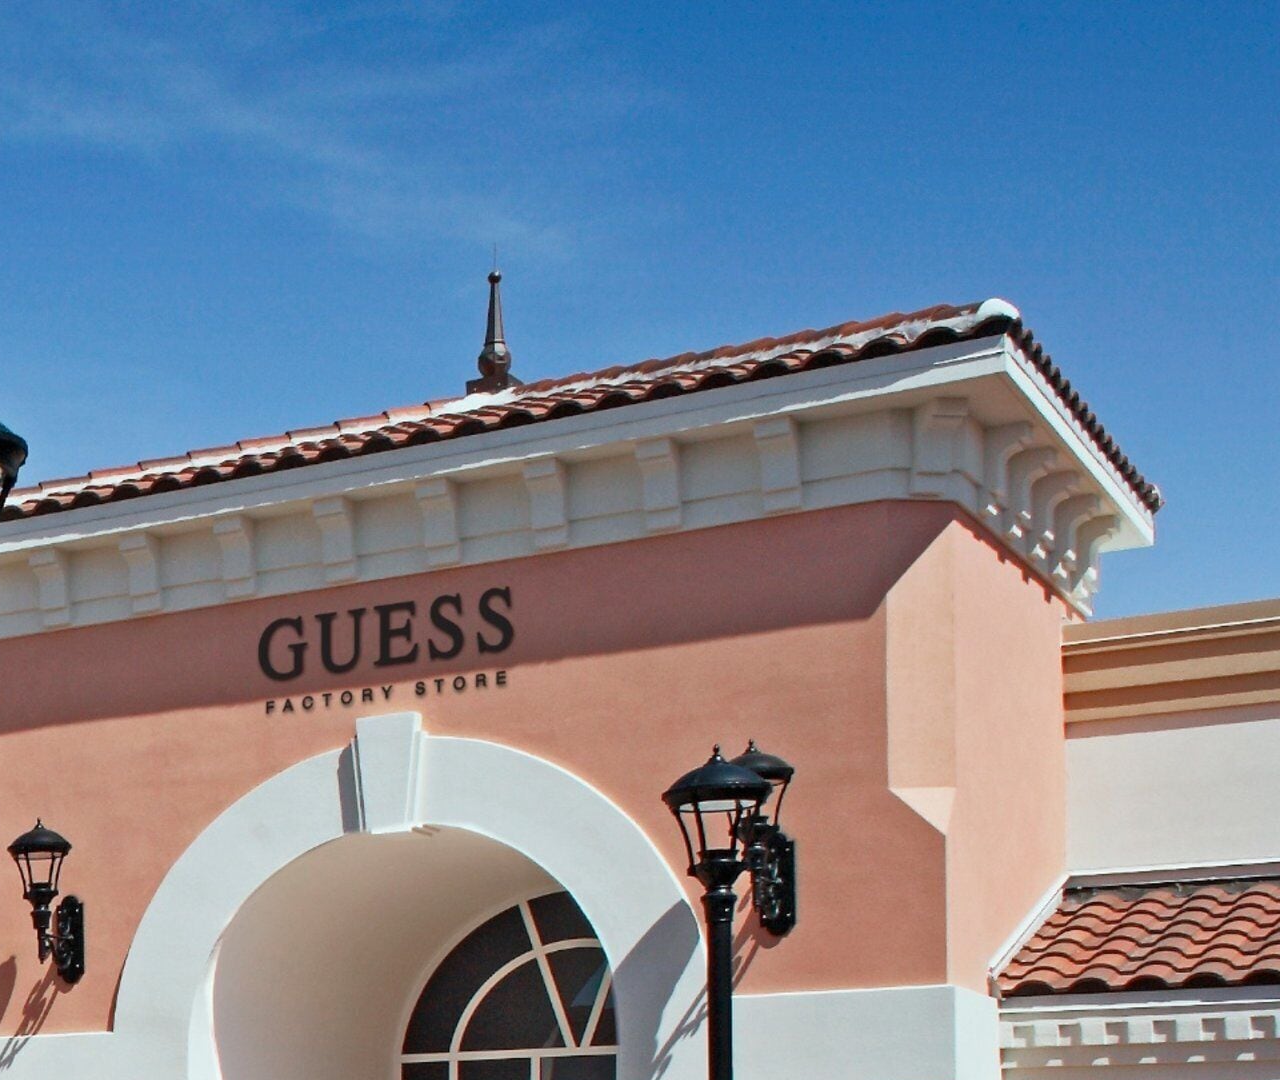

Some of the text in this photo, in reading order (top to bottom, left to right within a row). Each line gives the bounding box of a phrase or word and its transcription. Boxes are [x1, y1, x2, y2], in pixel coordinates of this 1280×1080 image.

[258, 586, 514, 681] GUESS
[266, 670, 509, 714] FACTORY STORE
